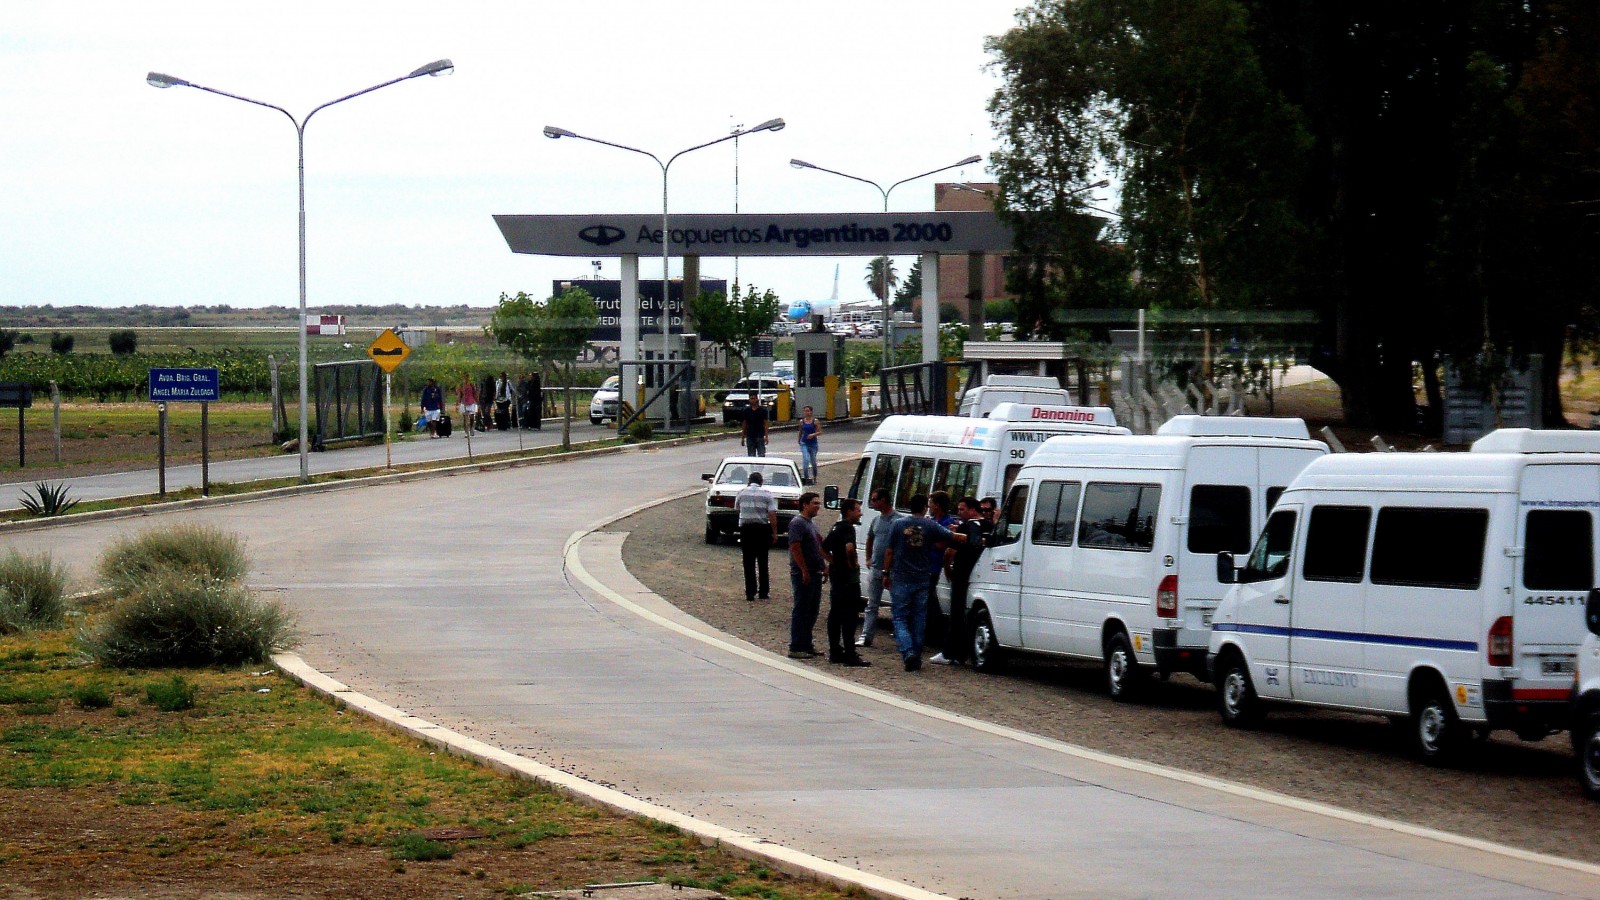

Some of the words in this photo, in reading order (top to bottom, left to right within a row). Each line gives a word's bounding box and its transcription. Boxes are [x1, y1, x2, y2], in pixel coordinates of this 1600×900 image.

[764, 223, 890, 248] Argentina
[893, 222, 953, 242] 2000
[641, 316, 654, 326] TE
[171, 386, 189, 396] MARIA
[1031, 407, 1095, 422] Danonino
[1010, 449, 1026, 459] 90
